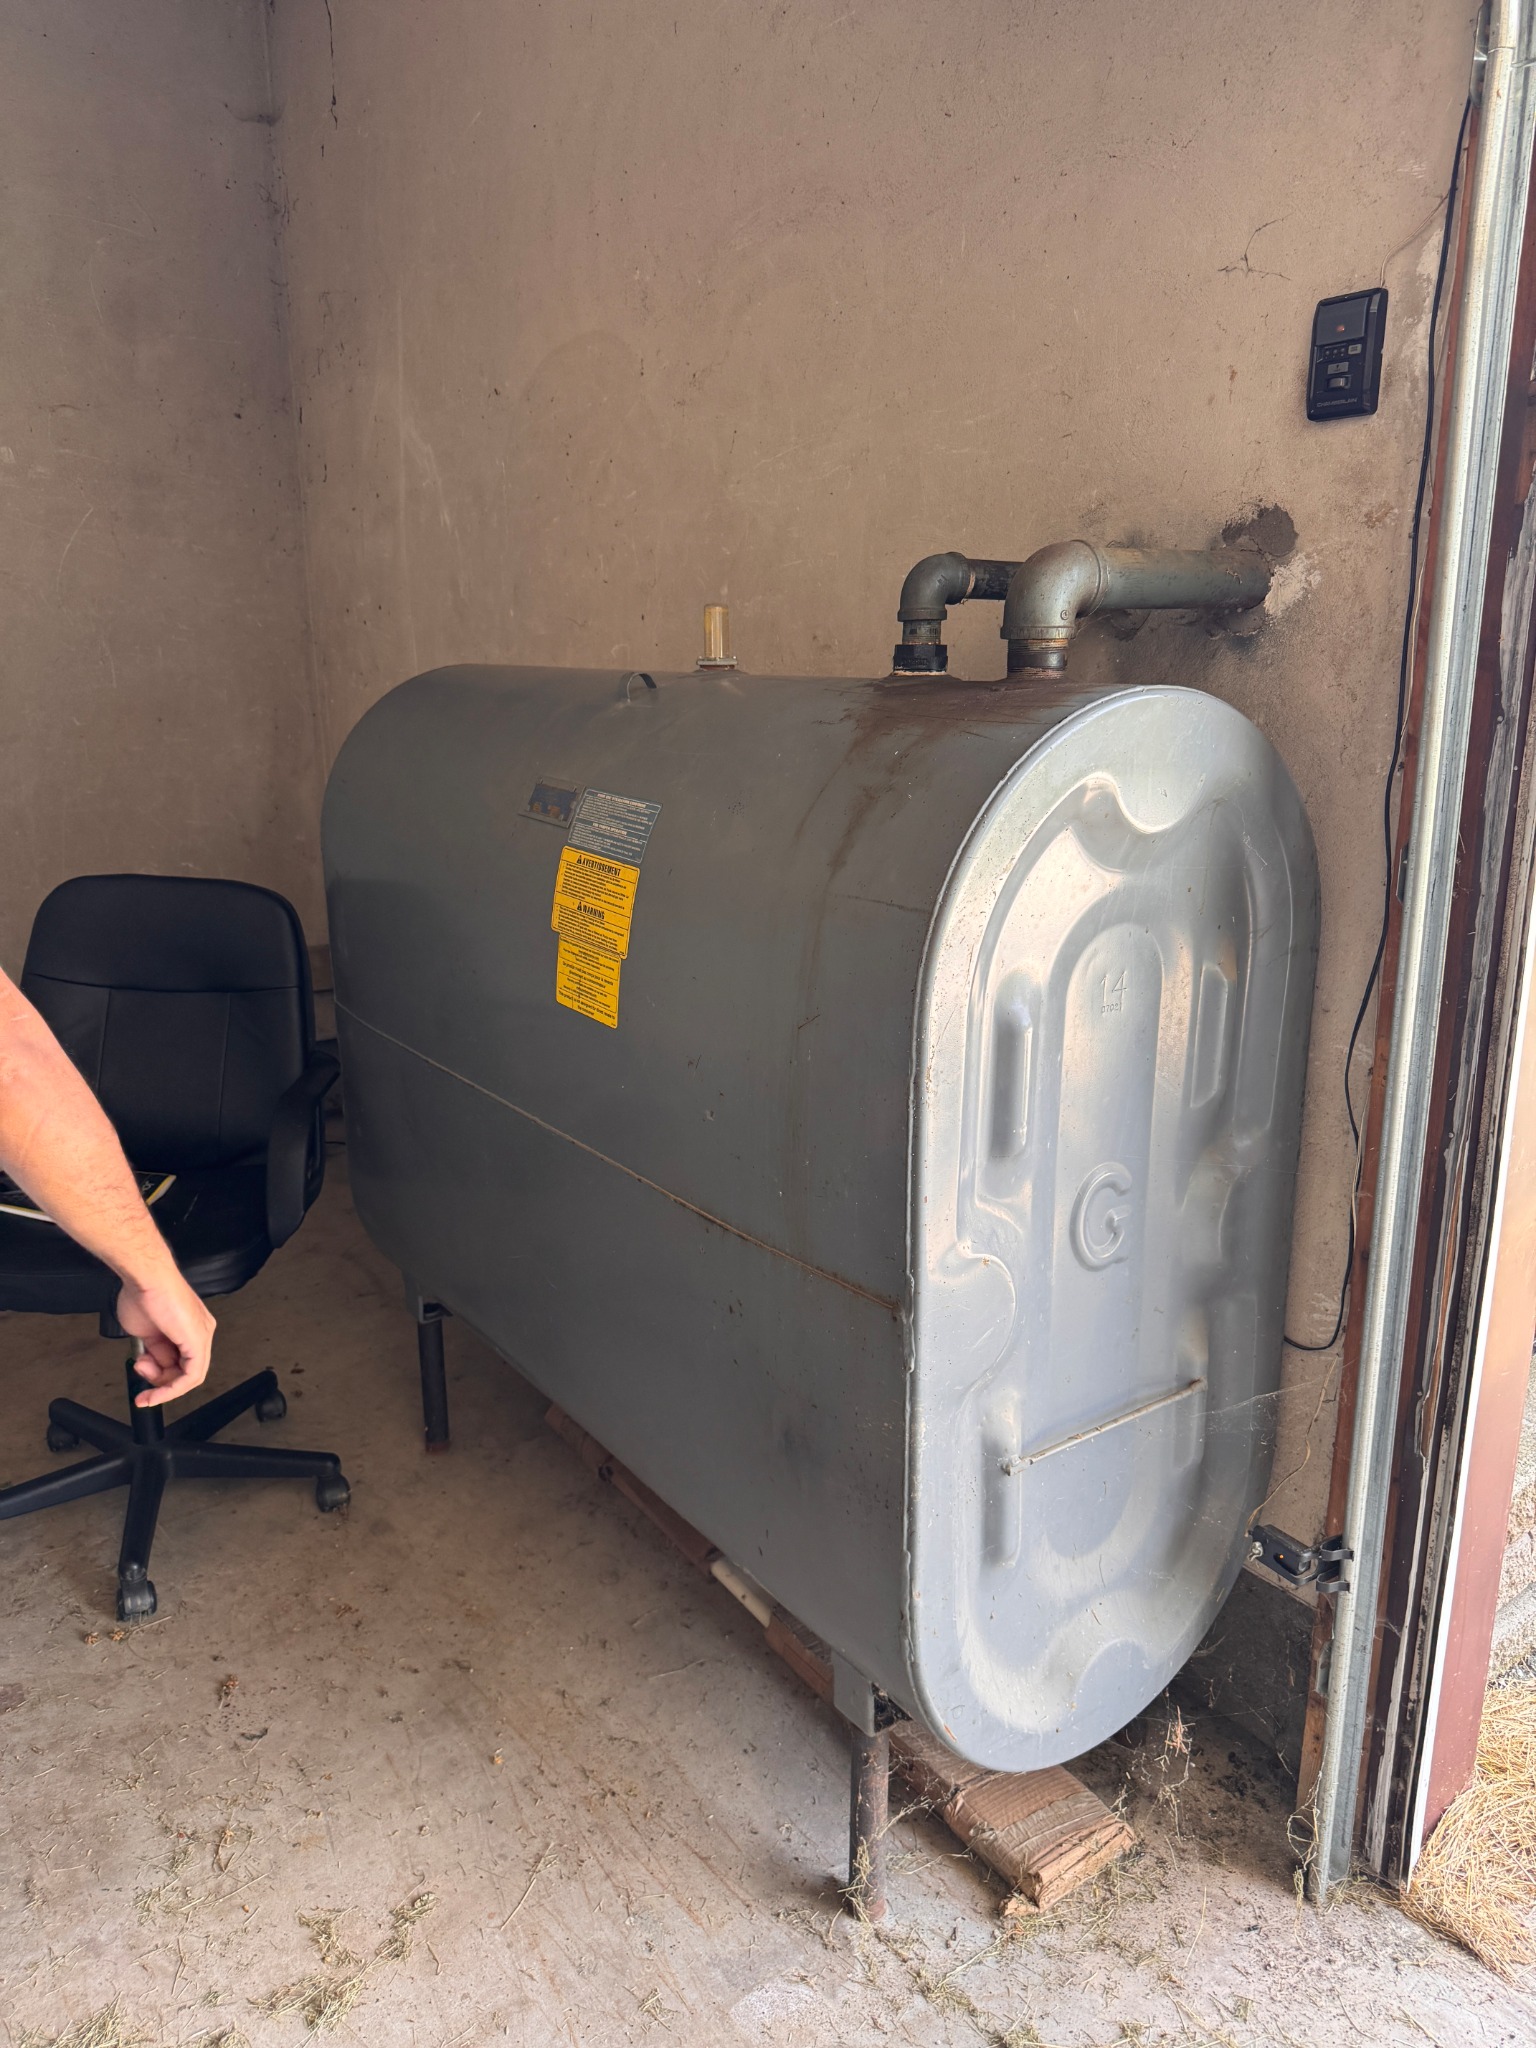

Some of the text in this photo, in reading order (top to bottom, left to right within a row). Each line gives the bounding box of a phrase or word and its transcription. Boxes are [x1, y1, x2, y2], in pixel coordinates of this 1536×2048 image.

[582, 857, 621, 877] AVERTISSEMENT
[582, 903, 605, 920] WARNING
[1100, 970, 1128, 1005] 14
[1069, 1162, 1131, 1272] G
